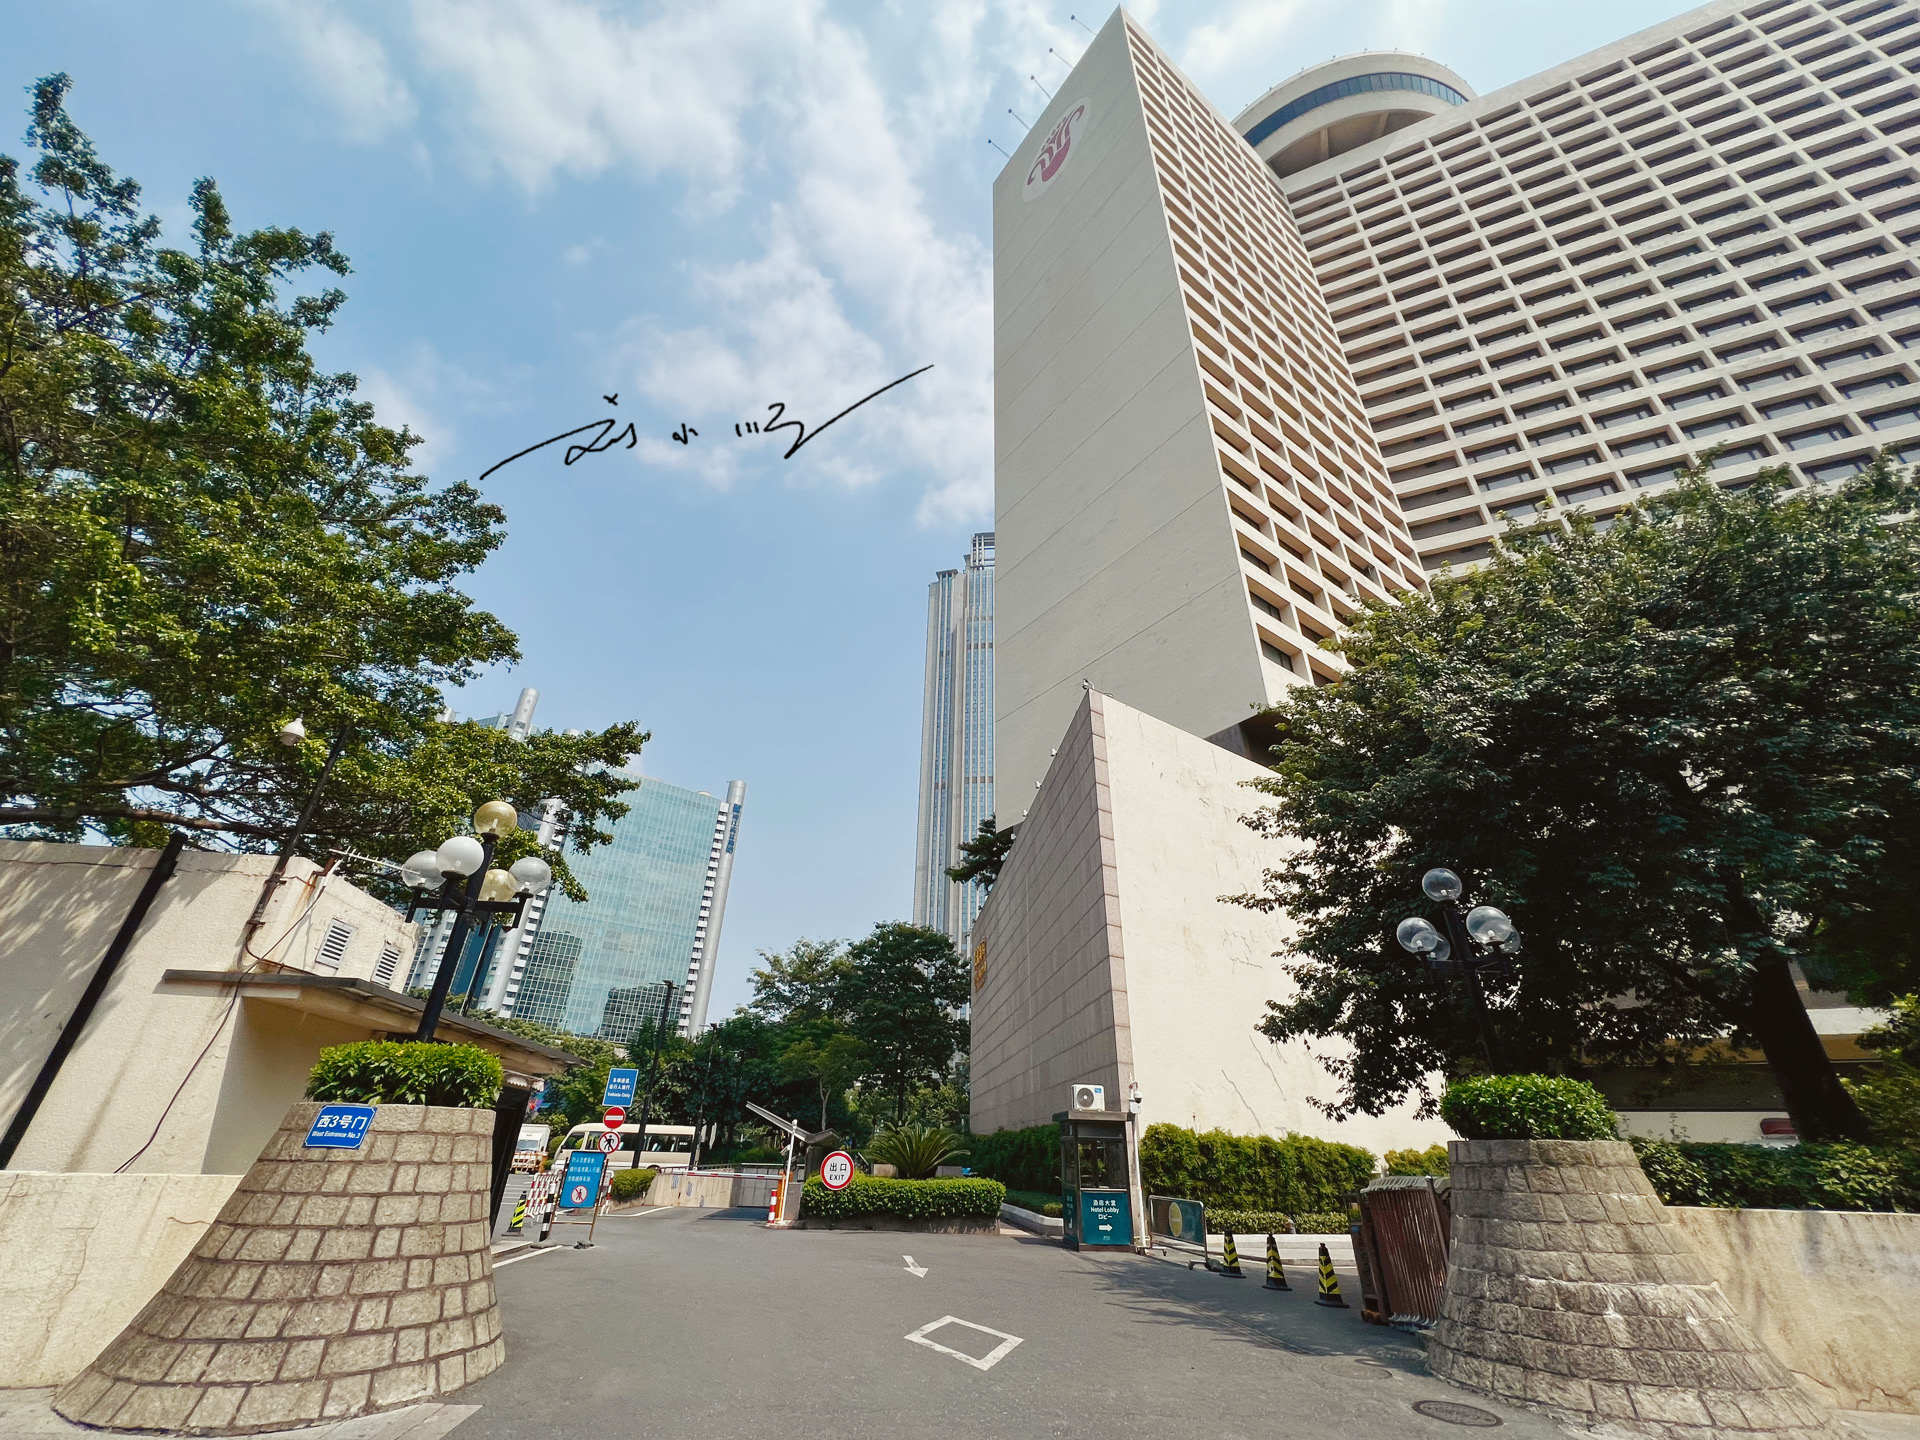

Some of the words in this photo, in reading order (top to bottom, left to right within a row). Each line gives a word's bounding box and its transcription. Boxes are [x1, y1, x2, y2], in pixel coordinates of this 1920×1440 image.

[317, 1115, 368, 1130] 西3号门
[830, 1162, 847, 1171] 出口
